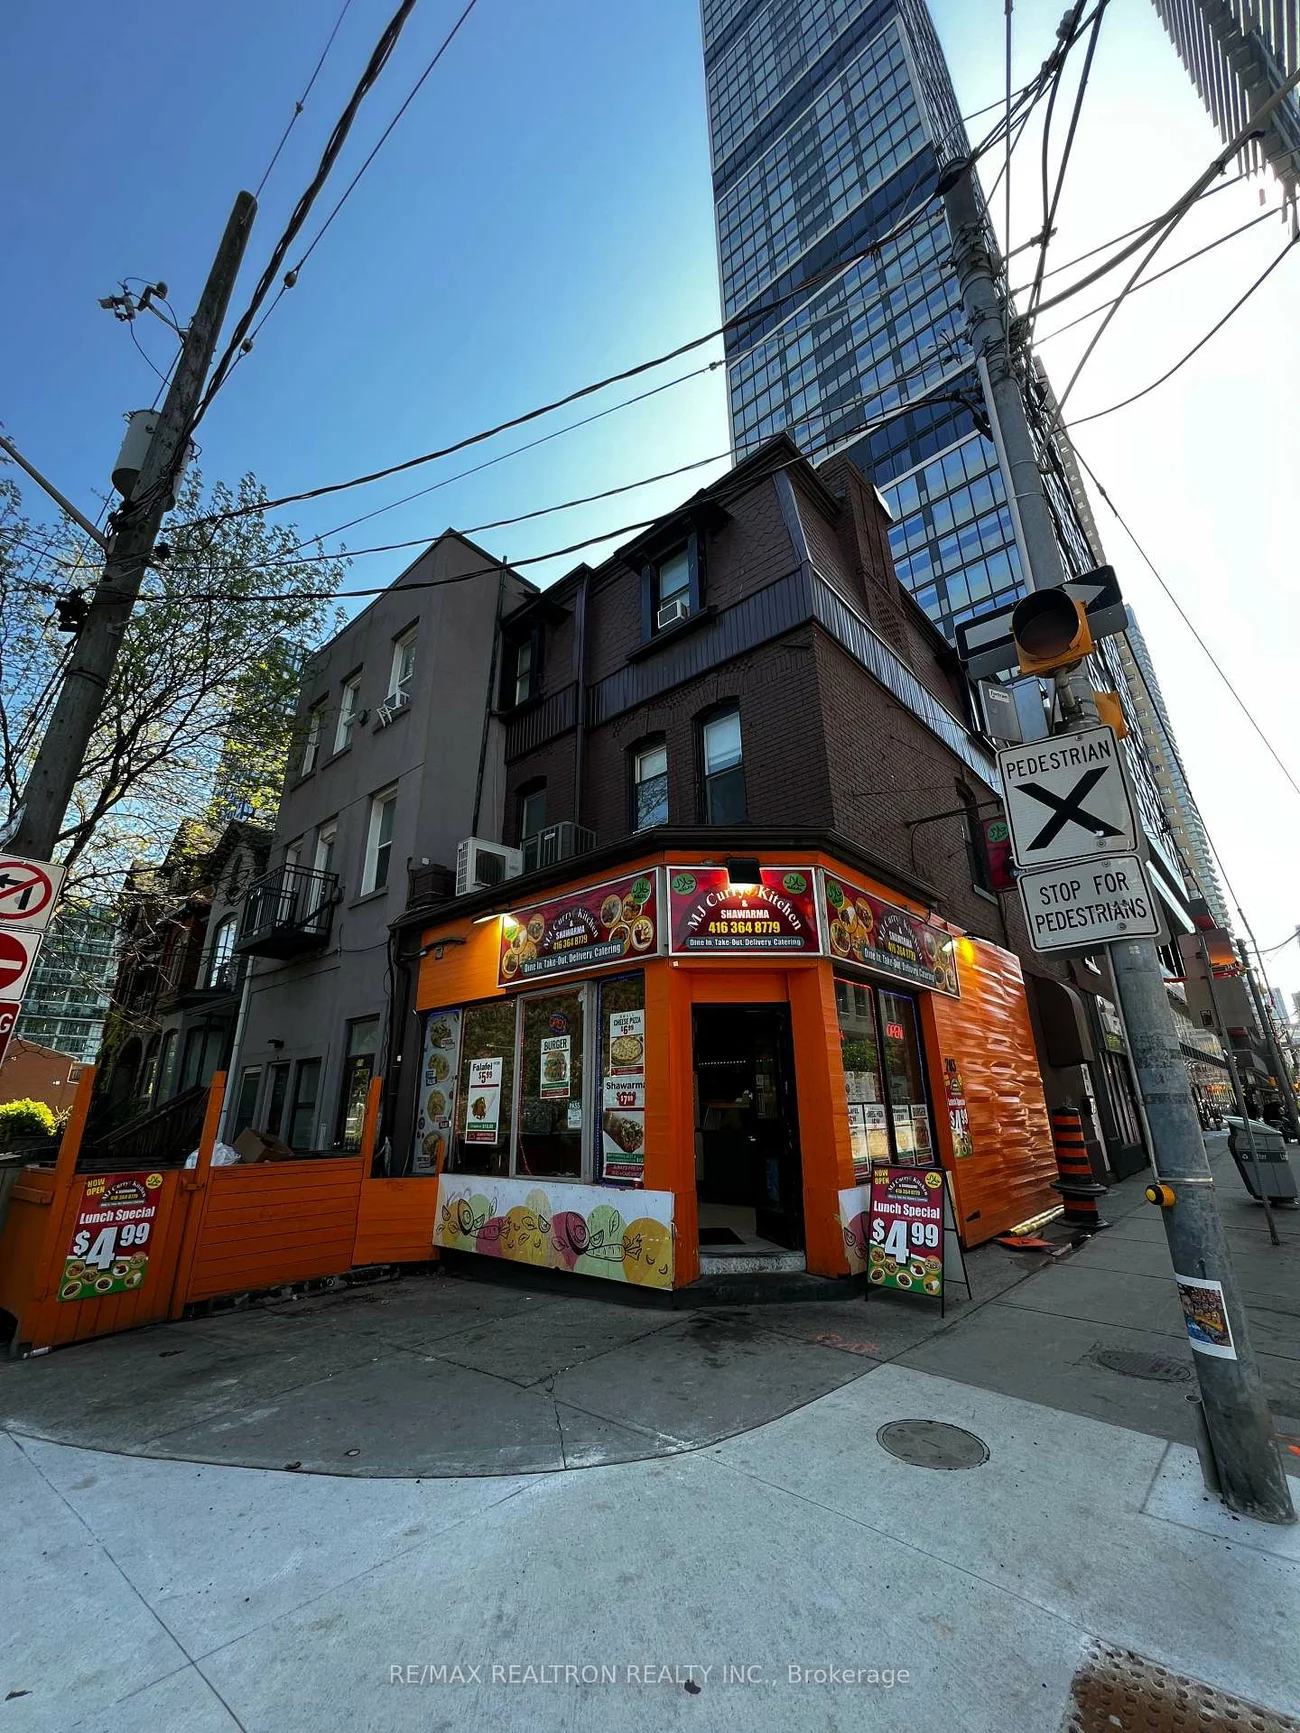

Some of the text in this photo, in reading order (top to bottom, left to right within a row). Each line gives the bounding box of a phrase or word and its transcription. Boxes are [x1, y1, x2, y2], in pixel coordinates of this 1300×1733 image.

[1007, 740, 1111, 779] PEDESTRIAN
[673, 876, 694, 889] حلال
[784, 874, 806, 888] حلال
[1040, 872, 1129, 905] STOP FOR
[688, 904, 708, 930] MJ
[758, 885, 801, 930] Kitchen
[741, 900, 748, 908] &
[720, 910, 770, 919] SHAWARMA
[1036, 898, 1147, 934] PEDESTRIANS
[578, 908, 598, 938] Kitchen
[708, 922, 780, 934] 416 364 8779
[553, 939, 563, 950] 416
[774, 938, 800, 947] Catering
[594, 944, 620, 958] Catering
[614, 1016, 641, 1026] CHEESE PIZZA
[887, 1024, 904, 1040] OPEN
[544, 1039, 567, 1051] BURGER
[473, 1062, 492, 1071] Falafel
[87, 1178, 106, 1187] NOW
[112, 1182, 128, 1190] Curry
[86, 1186, 106, 1196] OPEN
[80, 1206, 155, 1224] Lunch Special
[874, 1200, 940, 1219] Lunch Special
